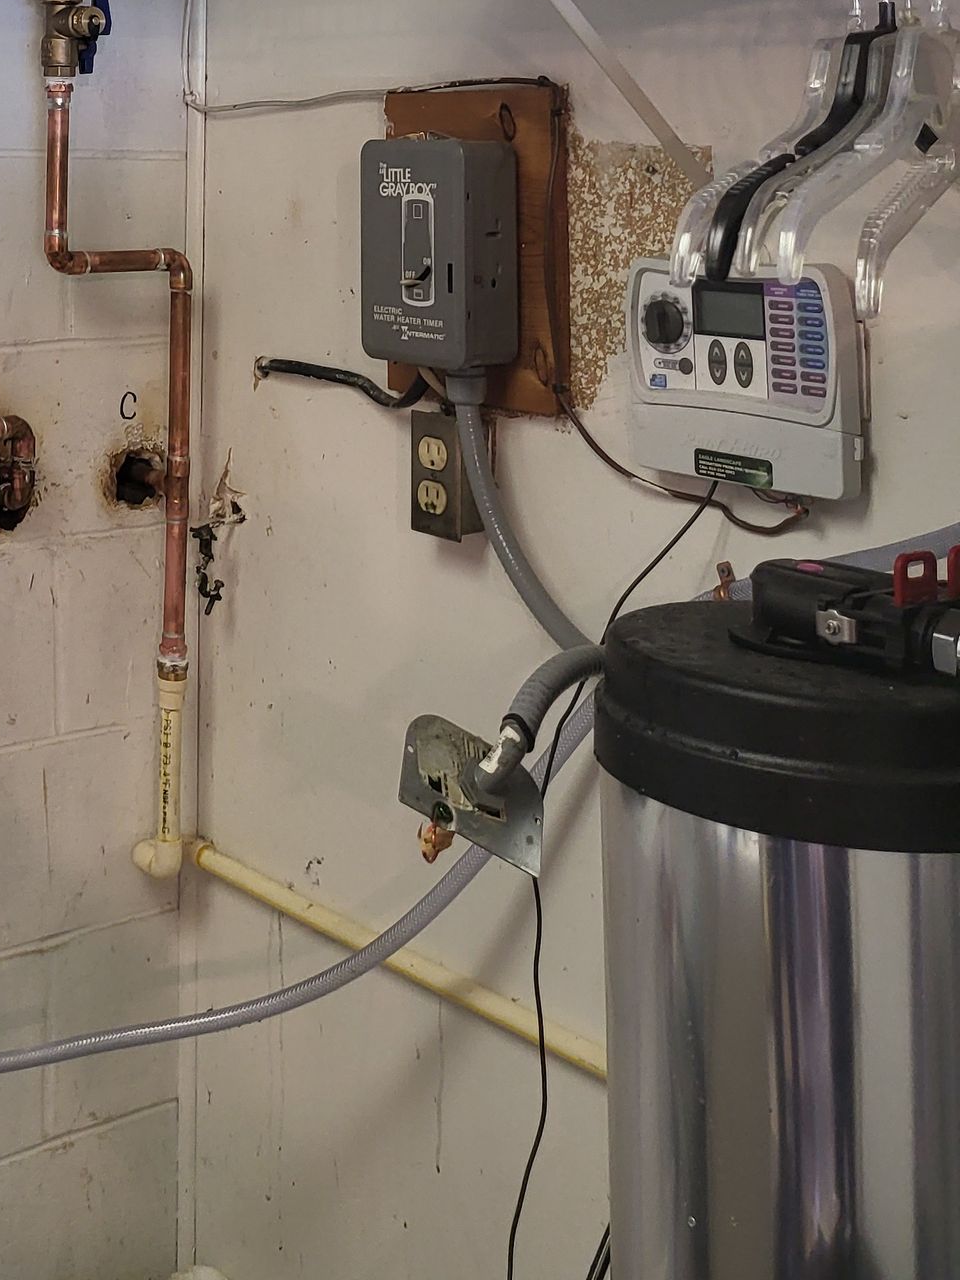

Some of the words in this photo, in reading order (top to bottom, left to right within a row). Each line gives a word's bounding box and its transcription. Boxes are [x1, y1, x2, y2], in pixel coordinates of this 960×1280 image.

[379, 182, 408, 197] GRAY
[422, 257, 432, 266] ON
[404, 270, 416, 279] OFF
[373, 305, 403, 315] ELECTRIC
[373, 313, 395, 322] WATER
[396, 316, 422, 325] HEATER
[423, 318, 444, 328] TIMER
[120, 391, 137, 420] C
